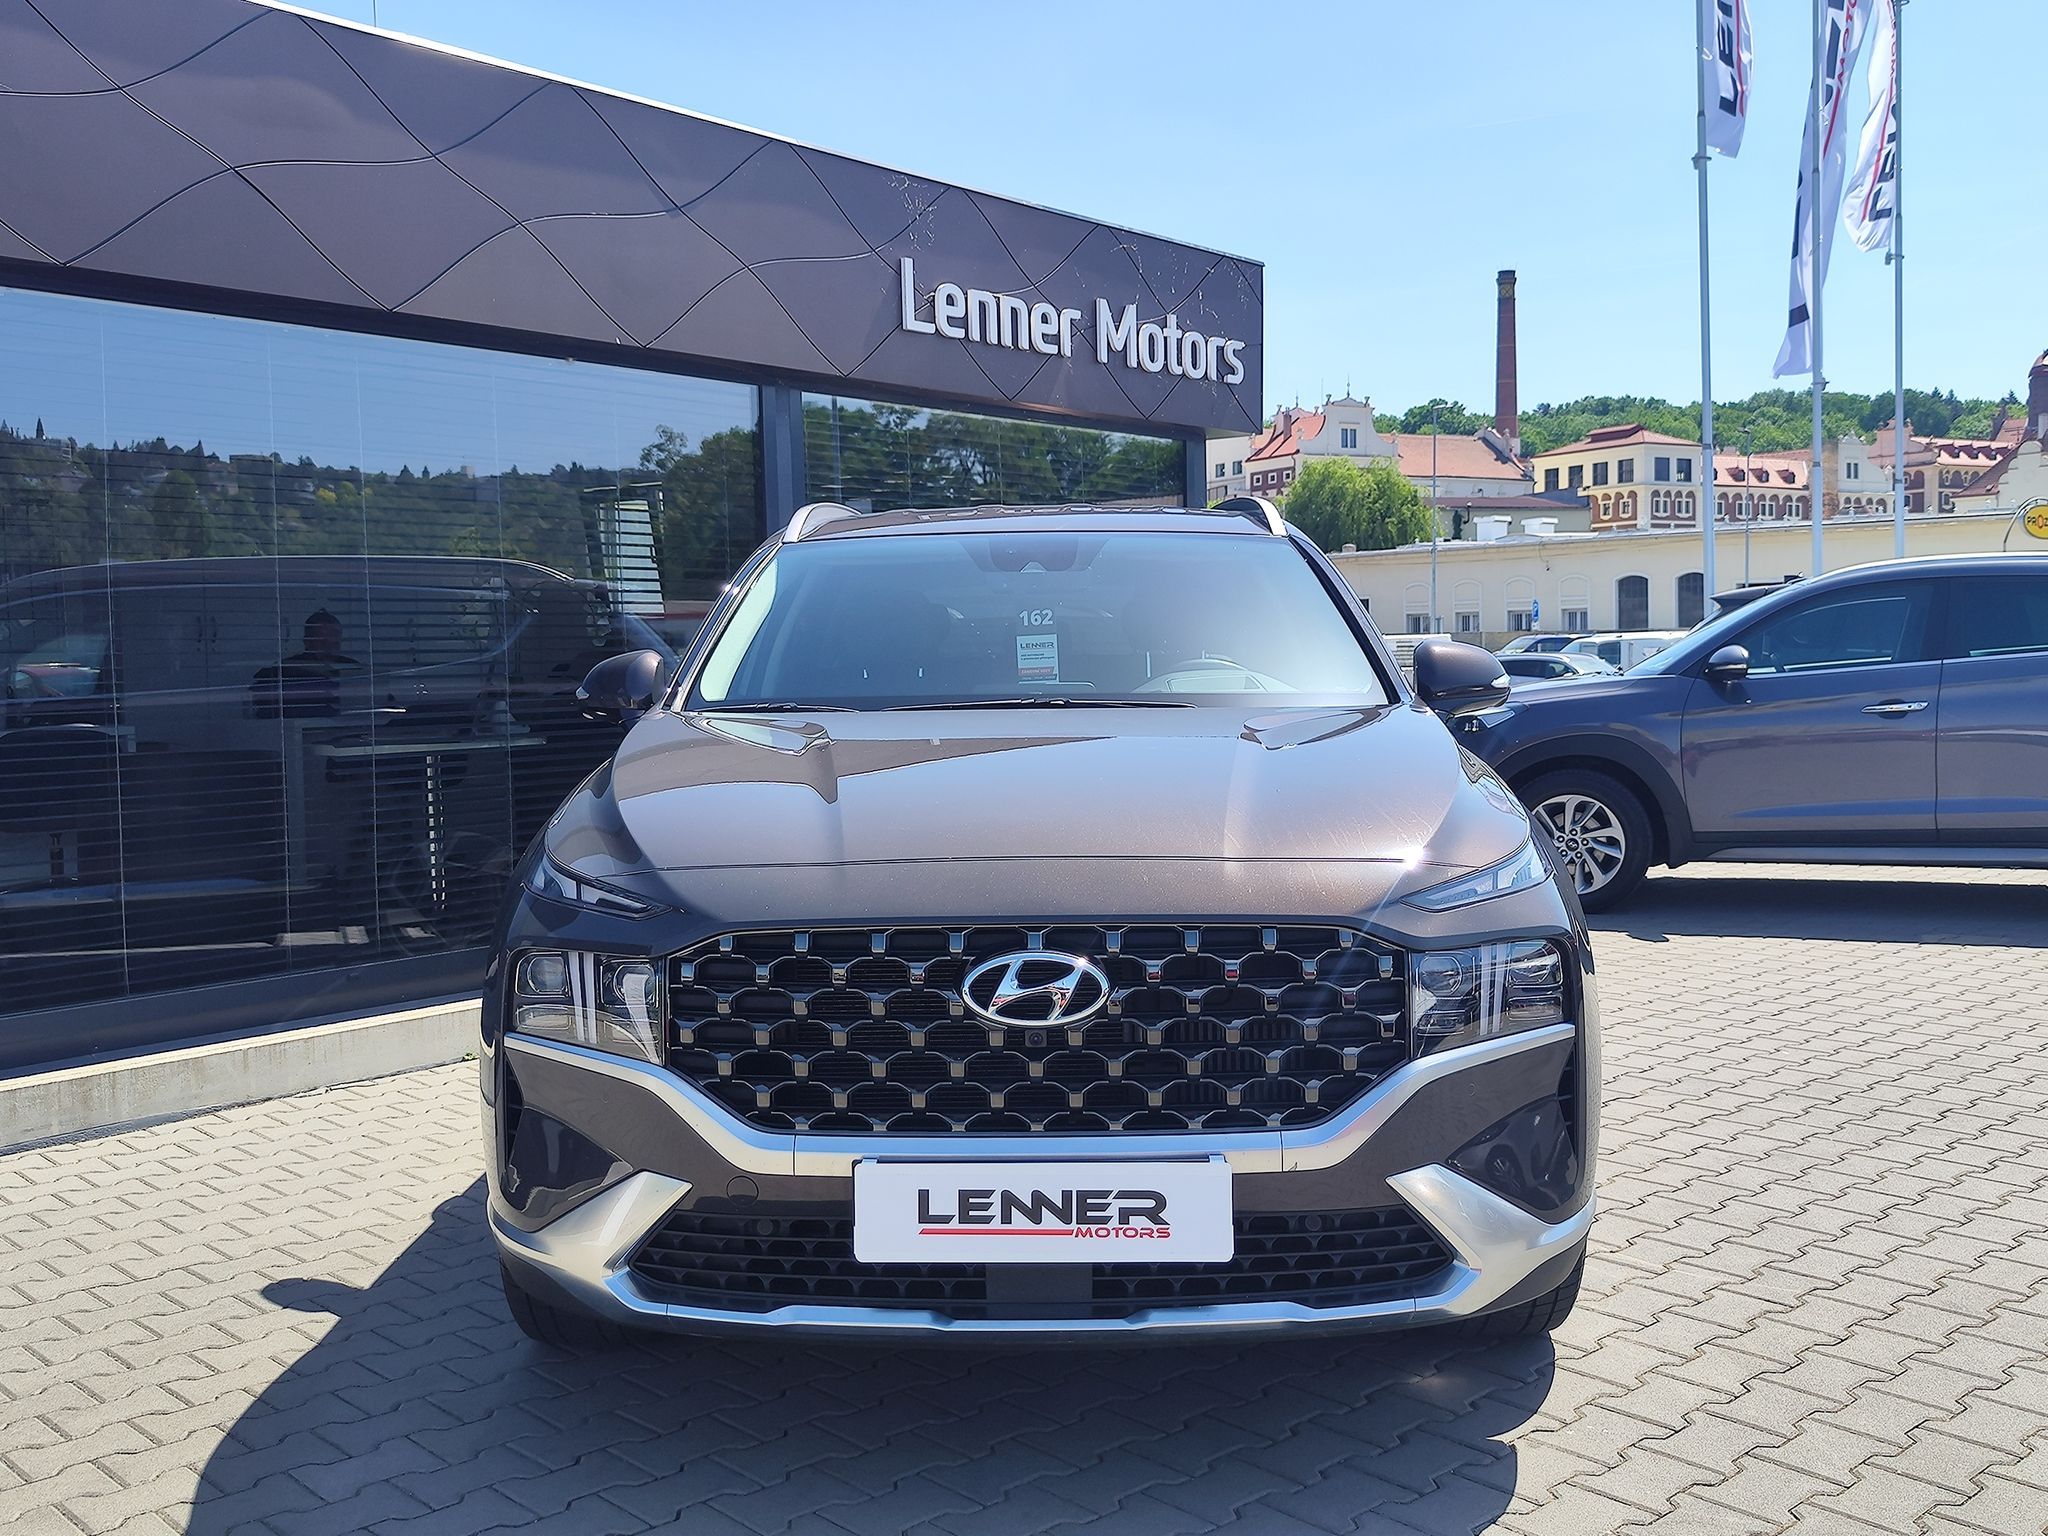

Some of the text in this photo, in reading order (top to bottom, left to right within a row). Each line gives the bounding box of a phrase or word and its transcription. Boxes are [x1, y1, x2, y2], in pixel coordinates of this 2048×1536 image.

[900, 257, 1246, 385] Lenner Motors
[1019, 609, 1053, 626] 162
[918, 1188, 1171, 1225] LENNER
[1074, 1226, 1171, 1239] MOTORS
